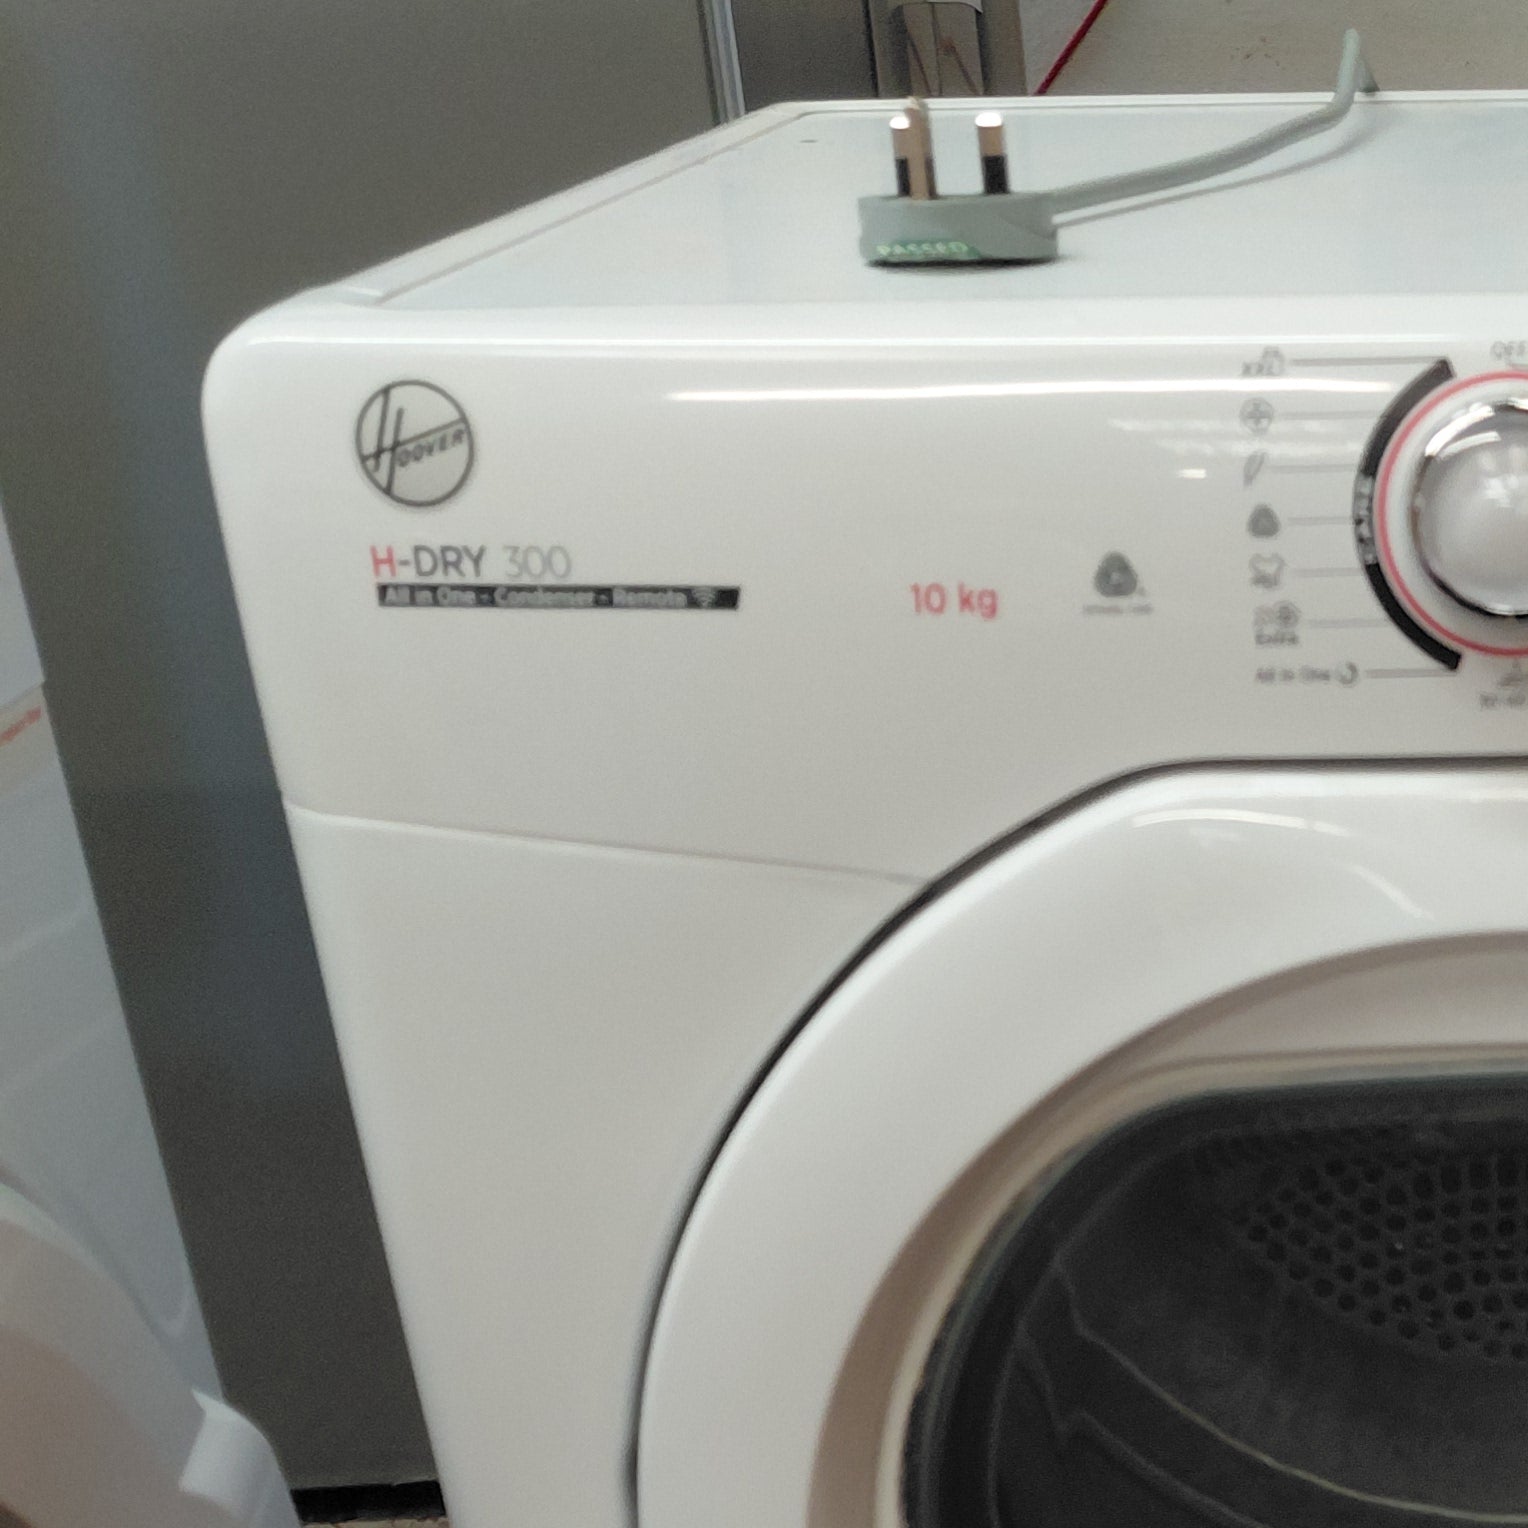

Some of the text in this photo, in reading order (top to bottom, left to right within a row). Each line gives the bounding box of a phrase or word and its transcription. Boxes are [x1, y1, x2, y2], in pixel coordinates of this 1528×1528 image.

[370, 545, 572, 578] H-DRY 300
[910, 581, 998, 619] 10 kg
